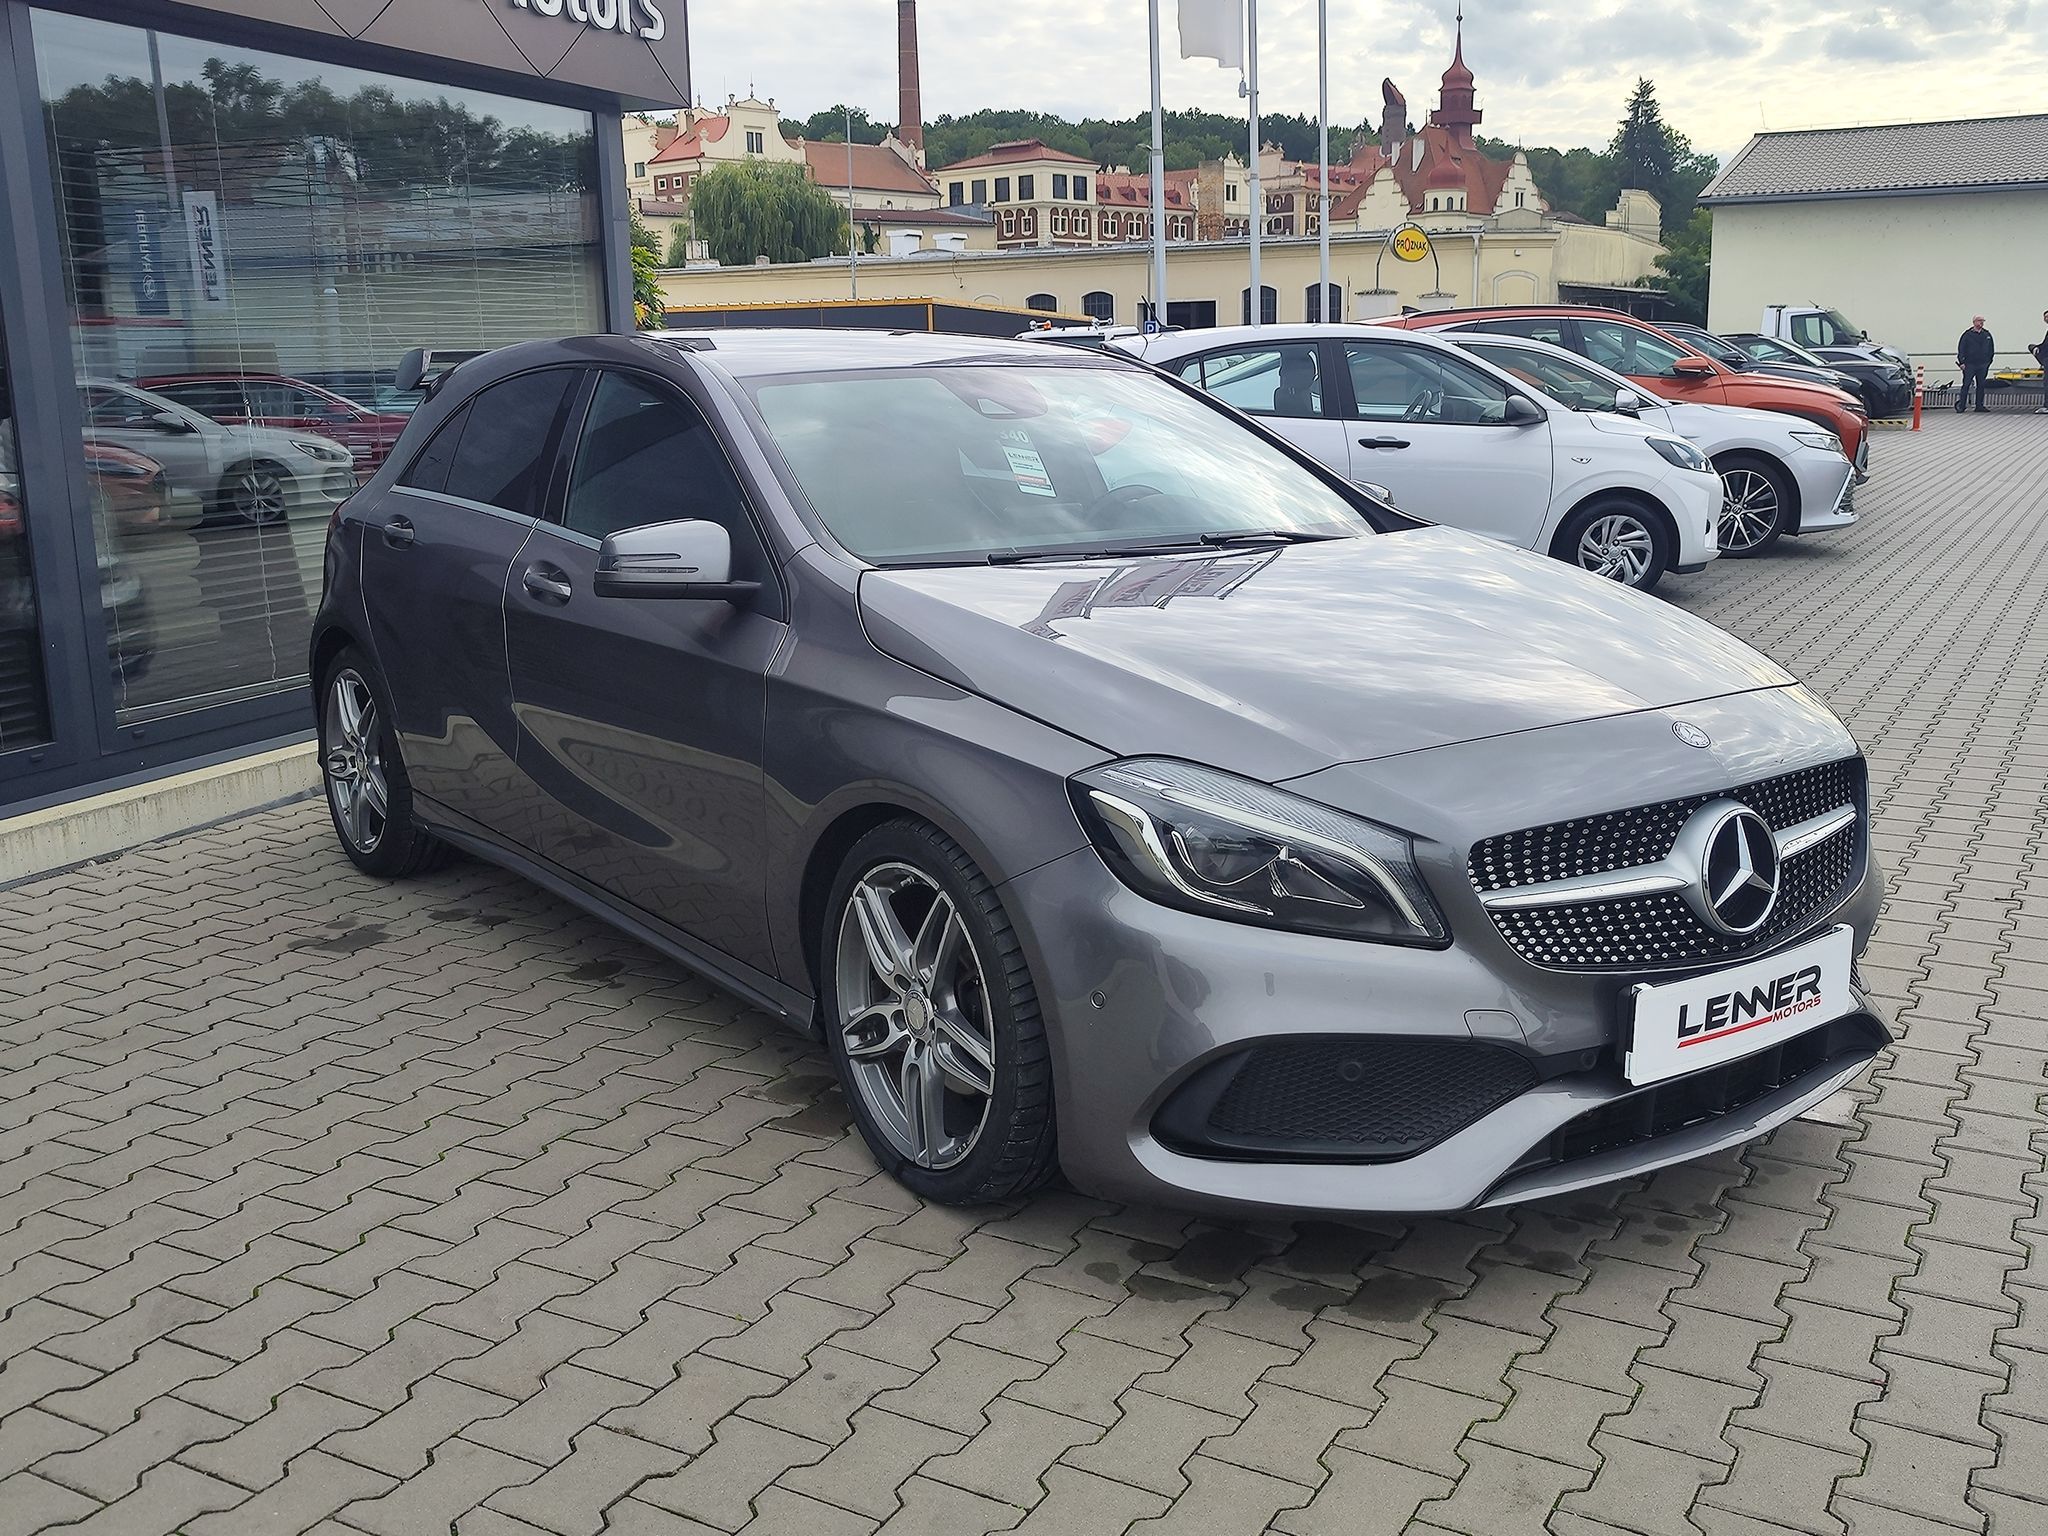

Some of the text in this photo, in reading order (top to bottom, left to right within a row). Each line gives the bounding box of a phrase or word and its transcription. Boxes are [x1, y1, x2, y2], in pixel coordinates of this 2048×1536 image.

[1396, 237, 1427, 252] PROZNAK
[1146, 323, 1155, 334] P
[1677, 964, 1822, 1039] LENNER
[1772, 995, 1822, 1022] MOTORS
